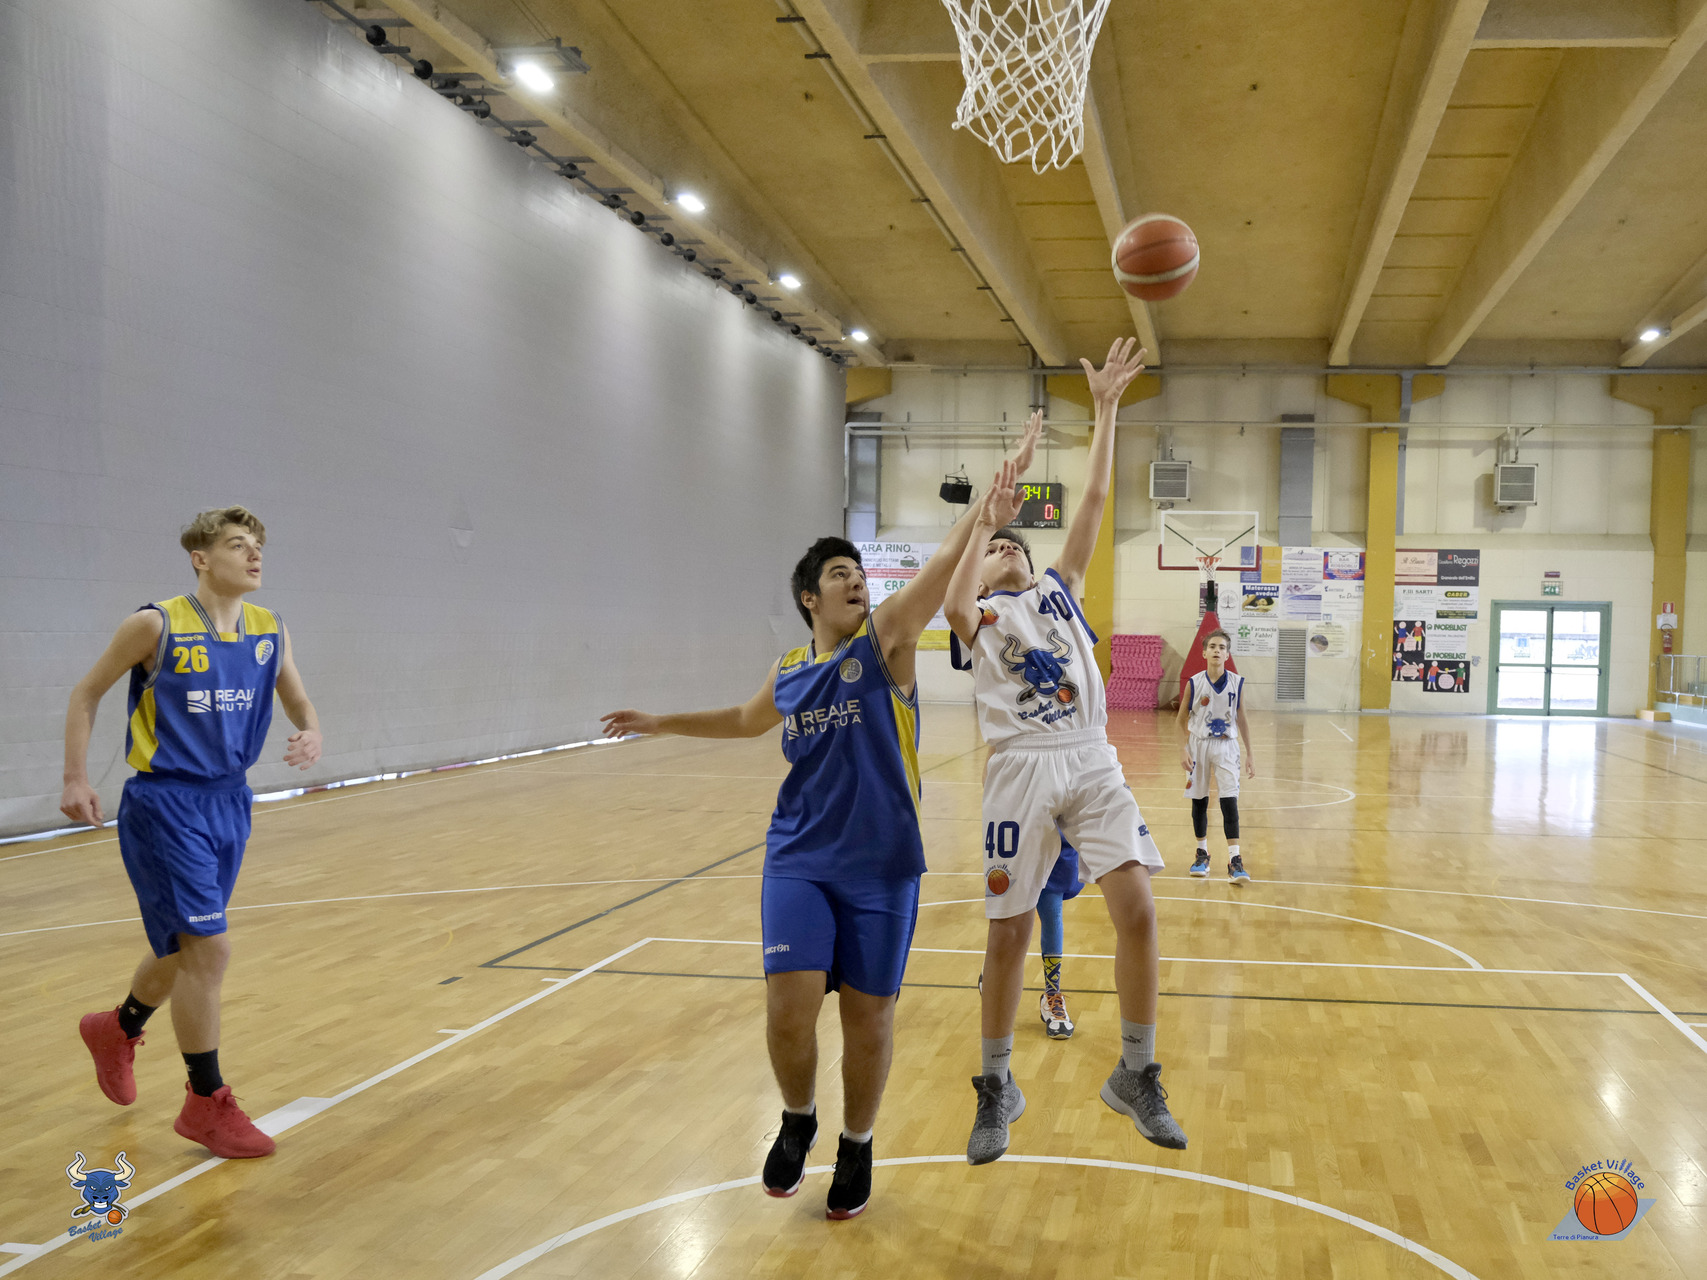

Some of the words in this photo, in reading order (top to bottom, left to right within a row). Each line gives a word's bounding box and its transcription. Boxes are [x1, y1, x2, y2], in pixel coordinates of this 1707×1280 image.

[860, 544, 883, 553] ARA
[885, 544, 911, 553] RINO
[1038, 591, 1074, 621] 40
[174, 634, 205, 643] macron
[172, 645, 210, 674] 26
[800, 699, 861, 726] REALE
[1018, 700, 1054, 720] Basket
[1042, 705, 1078, 724] Village
[803, 714, 862, 737] MUTUA
[985, 820, 1020, 859] 40
[188, 912, 223, 923] macron
